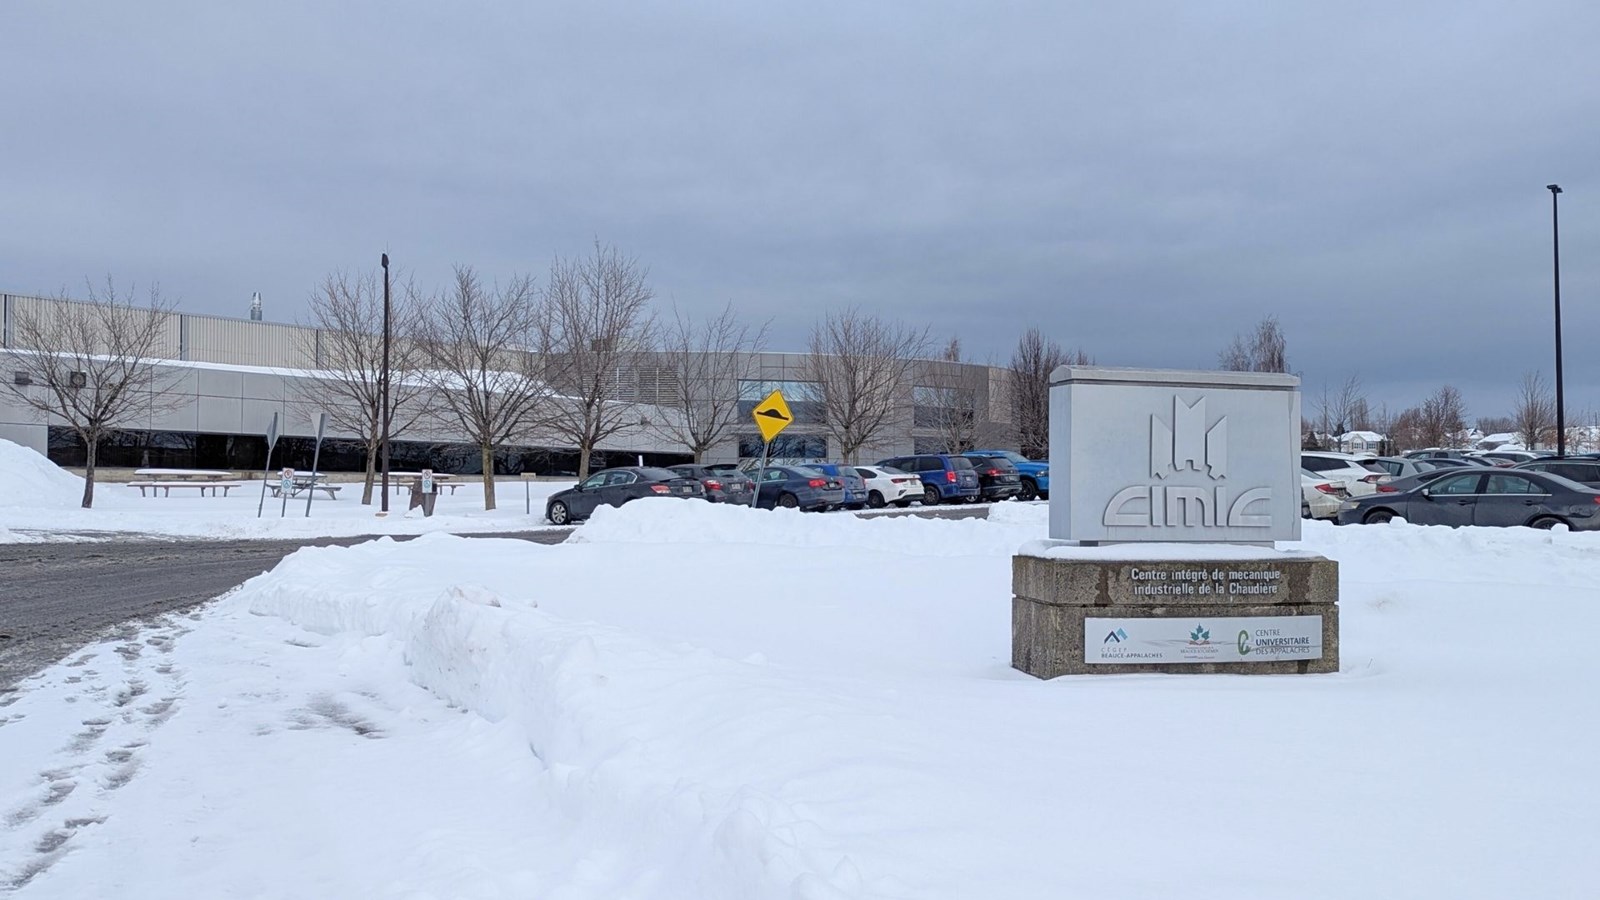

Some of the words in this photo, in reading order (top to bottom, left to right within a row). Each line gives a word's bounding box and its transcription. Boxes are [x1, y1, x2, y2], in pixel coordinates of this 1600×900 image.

[1131, 568, 1167, 580] Centre
[1171, 569, 1208, 582] intégré
[1211, 569, 1225, 580] de
[1134, 583, 1194, 595] industrielle
[1198, 583, 1211, 594] de
[1215, 583, 1225, 594] la
[1229, 582, 1278, 595] Chaudière
[1255, 637, 1310, 647] UNIVERSITAIRE
[1255, 647, 1269, 655] DES
[1270, 646, 1310, 654] APPALACHES
